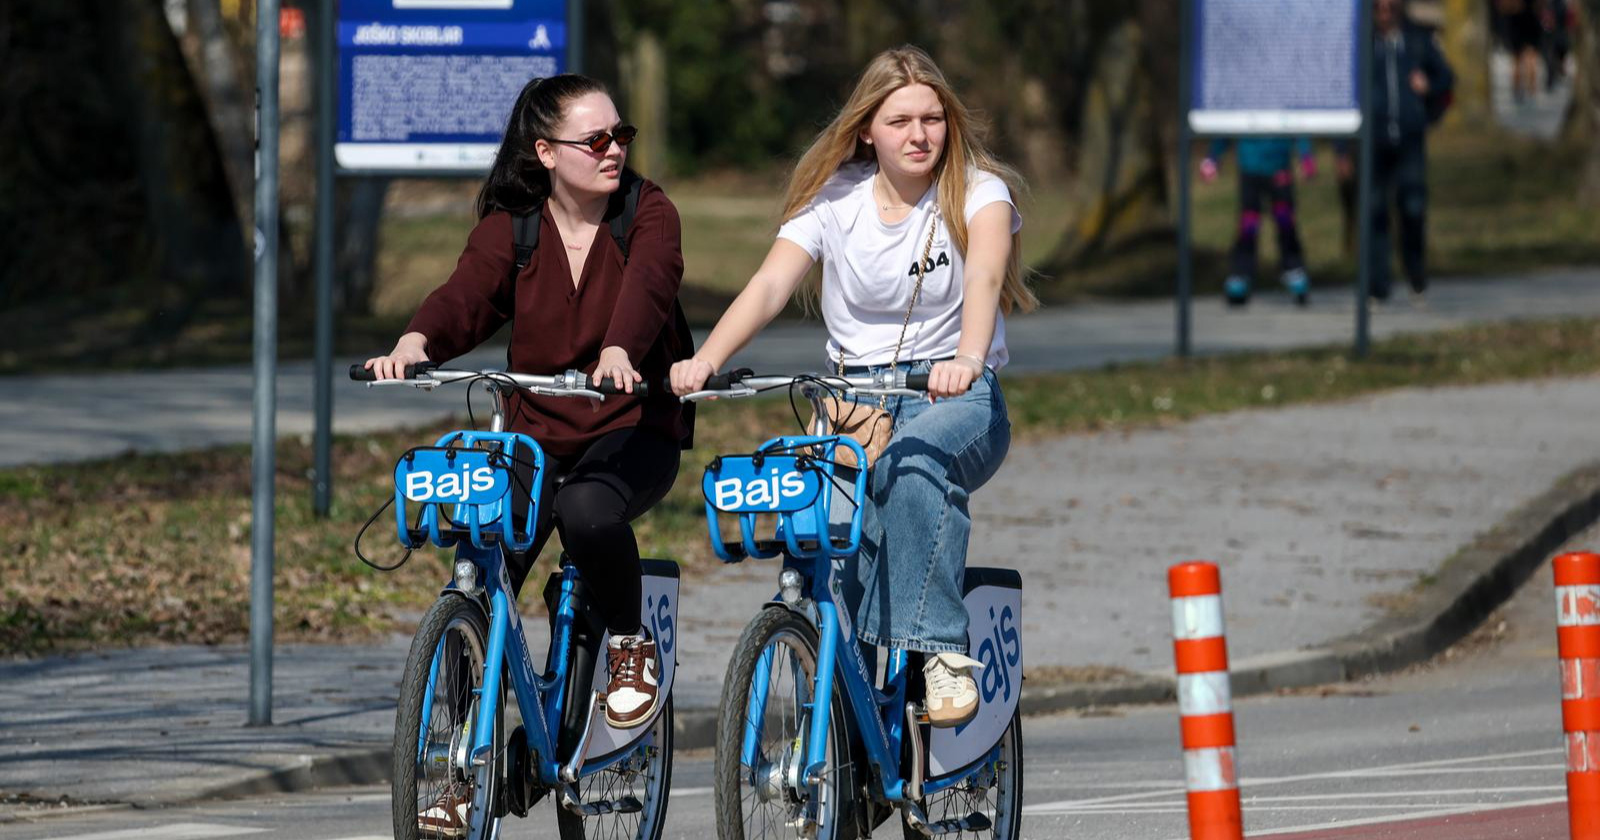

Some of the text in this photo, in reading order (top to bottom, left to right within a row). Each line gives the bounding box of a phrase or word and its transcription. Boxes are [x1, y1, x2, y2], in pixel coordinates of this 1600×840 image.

[908, 251, 950, 276] 404
[406, 463, 495, 502] Bajs
[714, 467, 805, 511] Bajs
[647, 594, 674, 688] js
